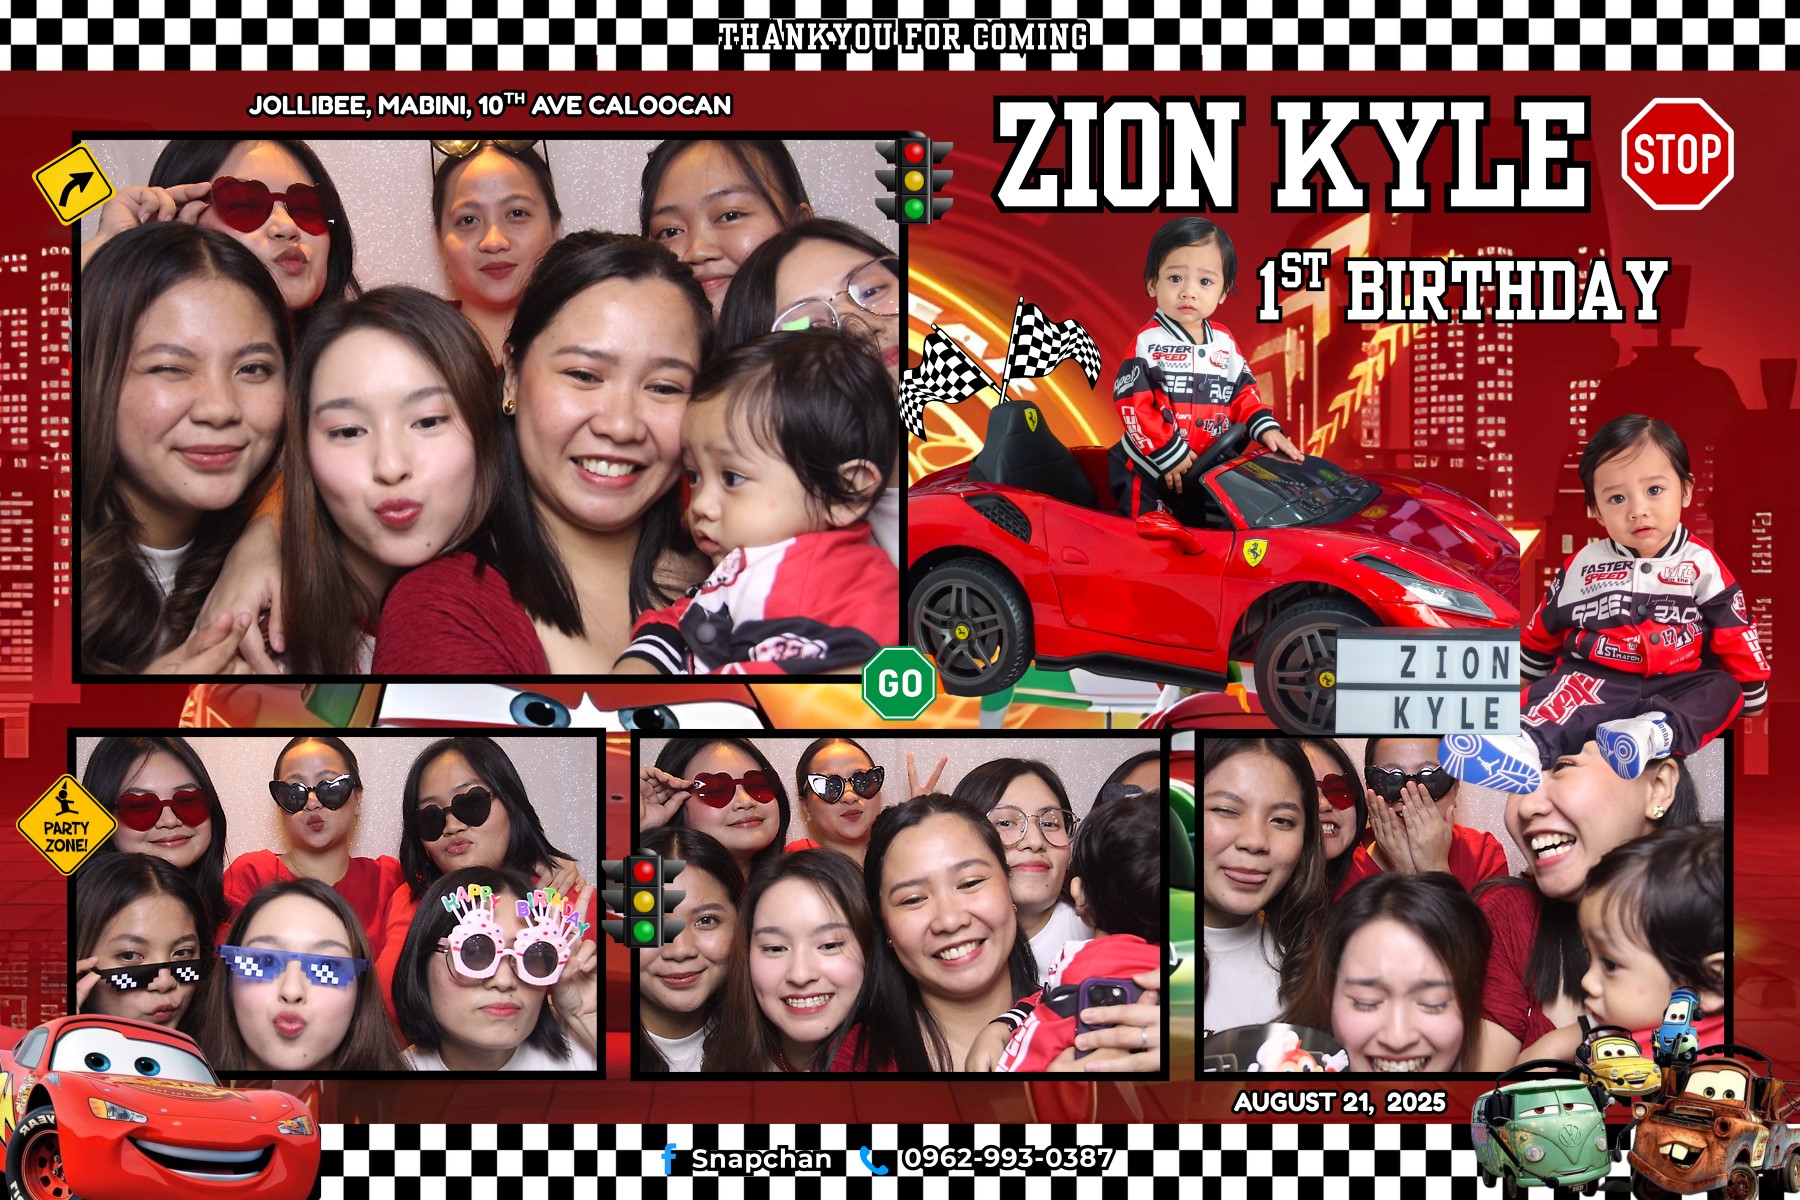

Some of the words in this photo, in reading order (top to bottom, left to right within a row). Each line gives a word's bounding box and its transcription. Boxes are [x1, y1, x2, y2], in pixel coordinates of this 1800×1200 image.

[1633, 134, 1722, 175] STOP
[1148, 344, 1192, 354] FASTER
[1152, 352, 1188, 361] SPEED
[1581, 561, 1633, 576] FASTER
[1584, 571, 1628, 585] SPEED
[1400, 645, 1510, 680] ZION
[878, 669, 923, 698] GO
[1393, 696, 1500, 730] KYLE
[44, 821, 90, 836] PARTY
[44, 838, 89, 853] ZONE!
[441, 884, 501, 913] HAPPY
[516, 887, 590, 937] BIRTHDAY
